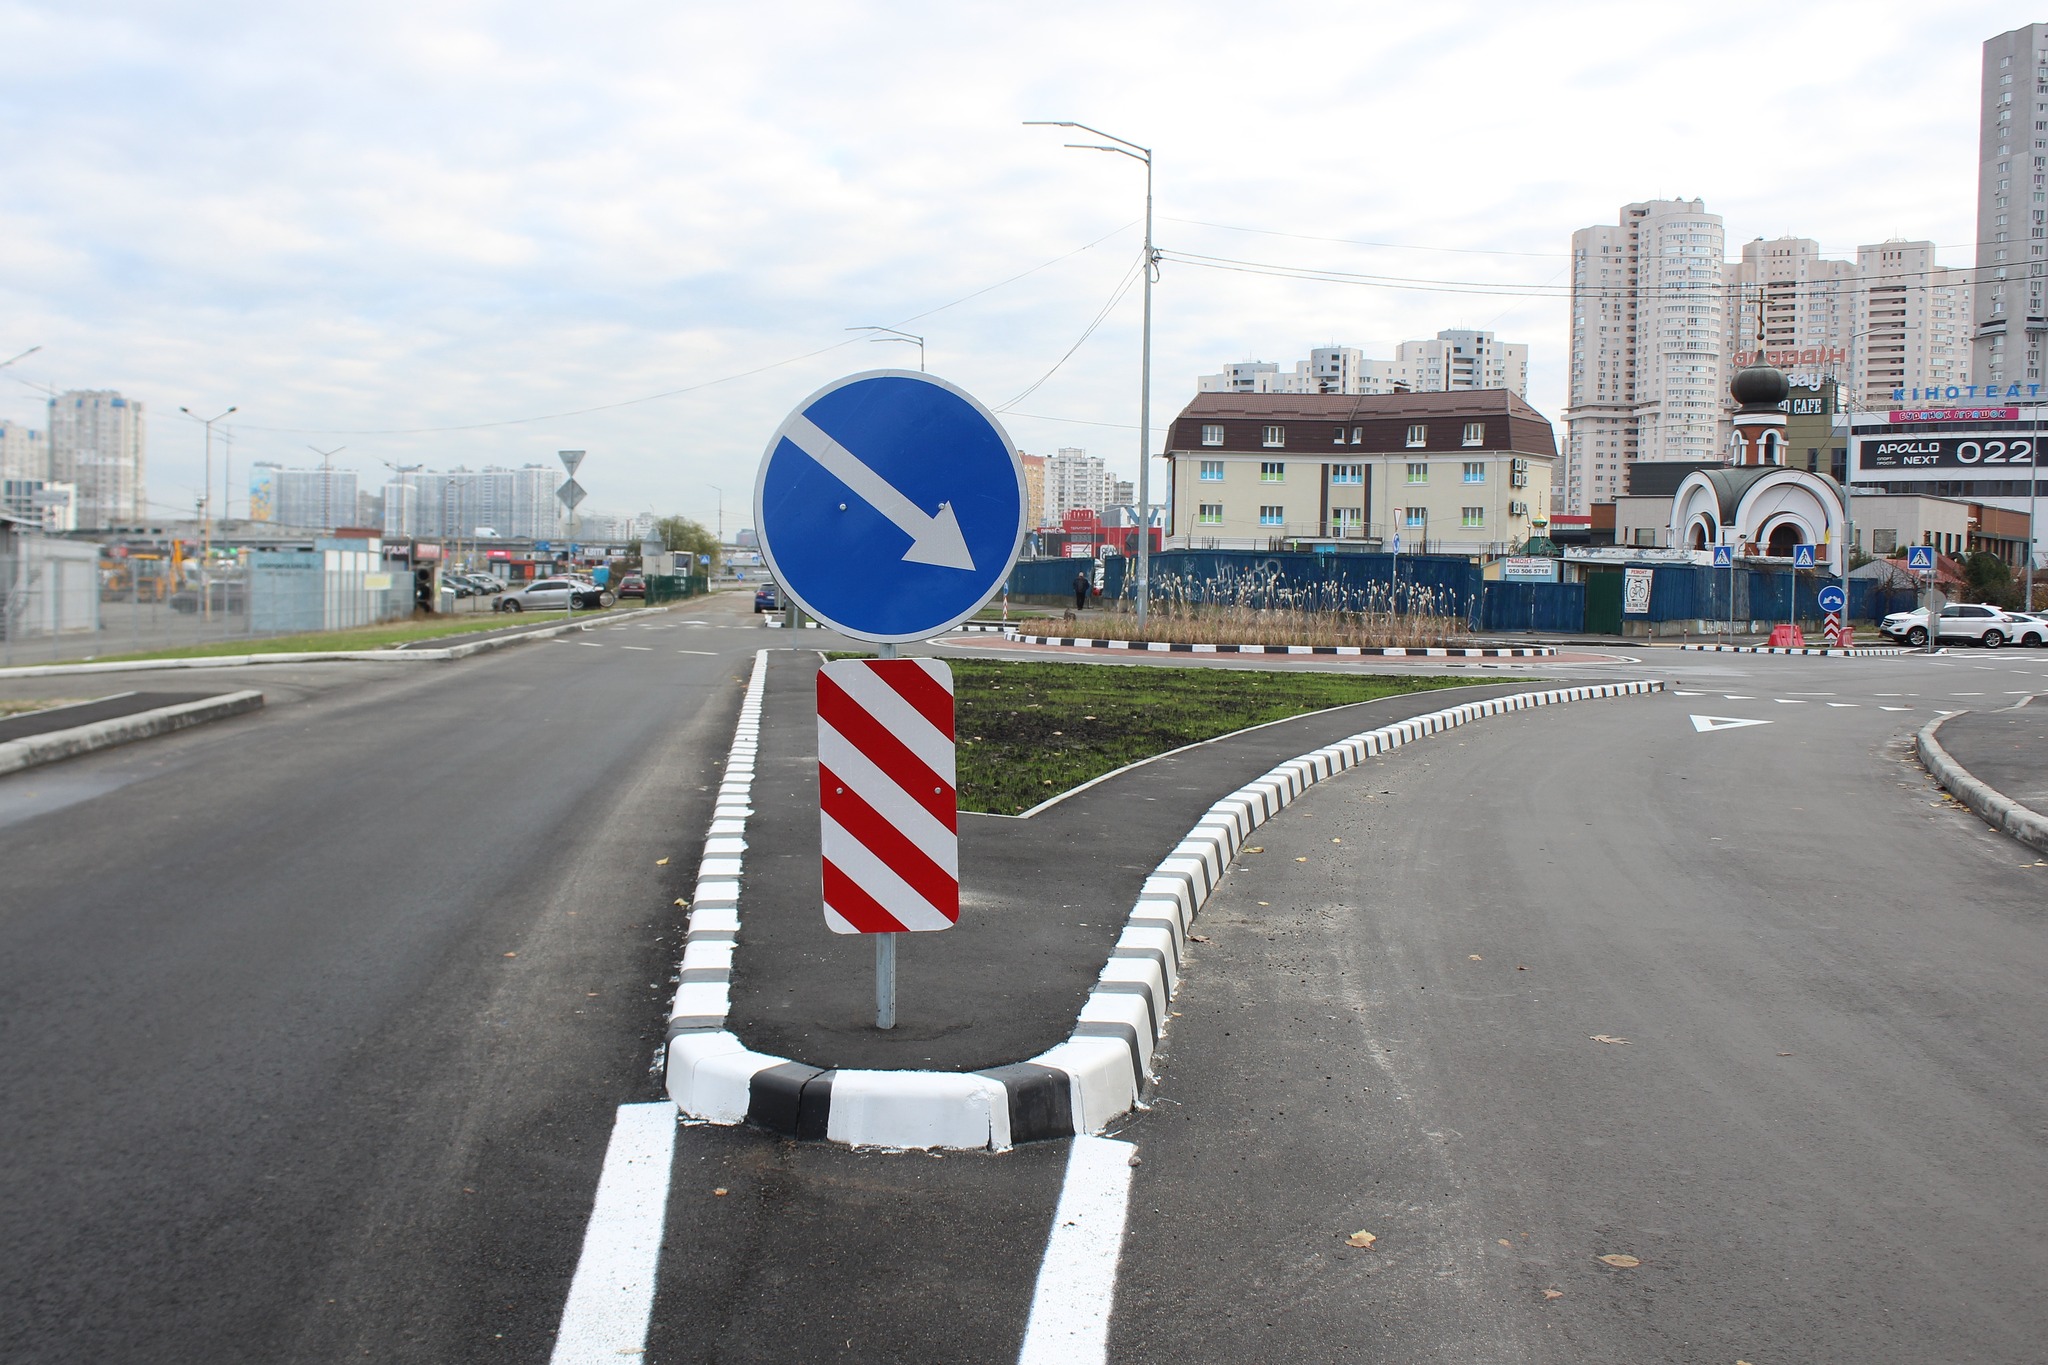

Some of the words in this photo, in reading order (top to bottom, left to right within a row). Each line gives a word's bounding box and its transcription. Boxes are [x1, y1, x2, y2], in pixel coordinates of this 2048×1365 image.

[1794, 399, 1821, 414] CAFE
[1899, 411, 1951, 421] БУДИНОК
[1877, 442, 1940, 454] APOLLO
[1903, 455, 1940, 465] NEXT
